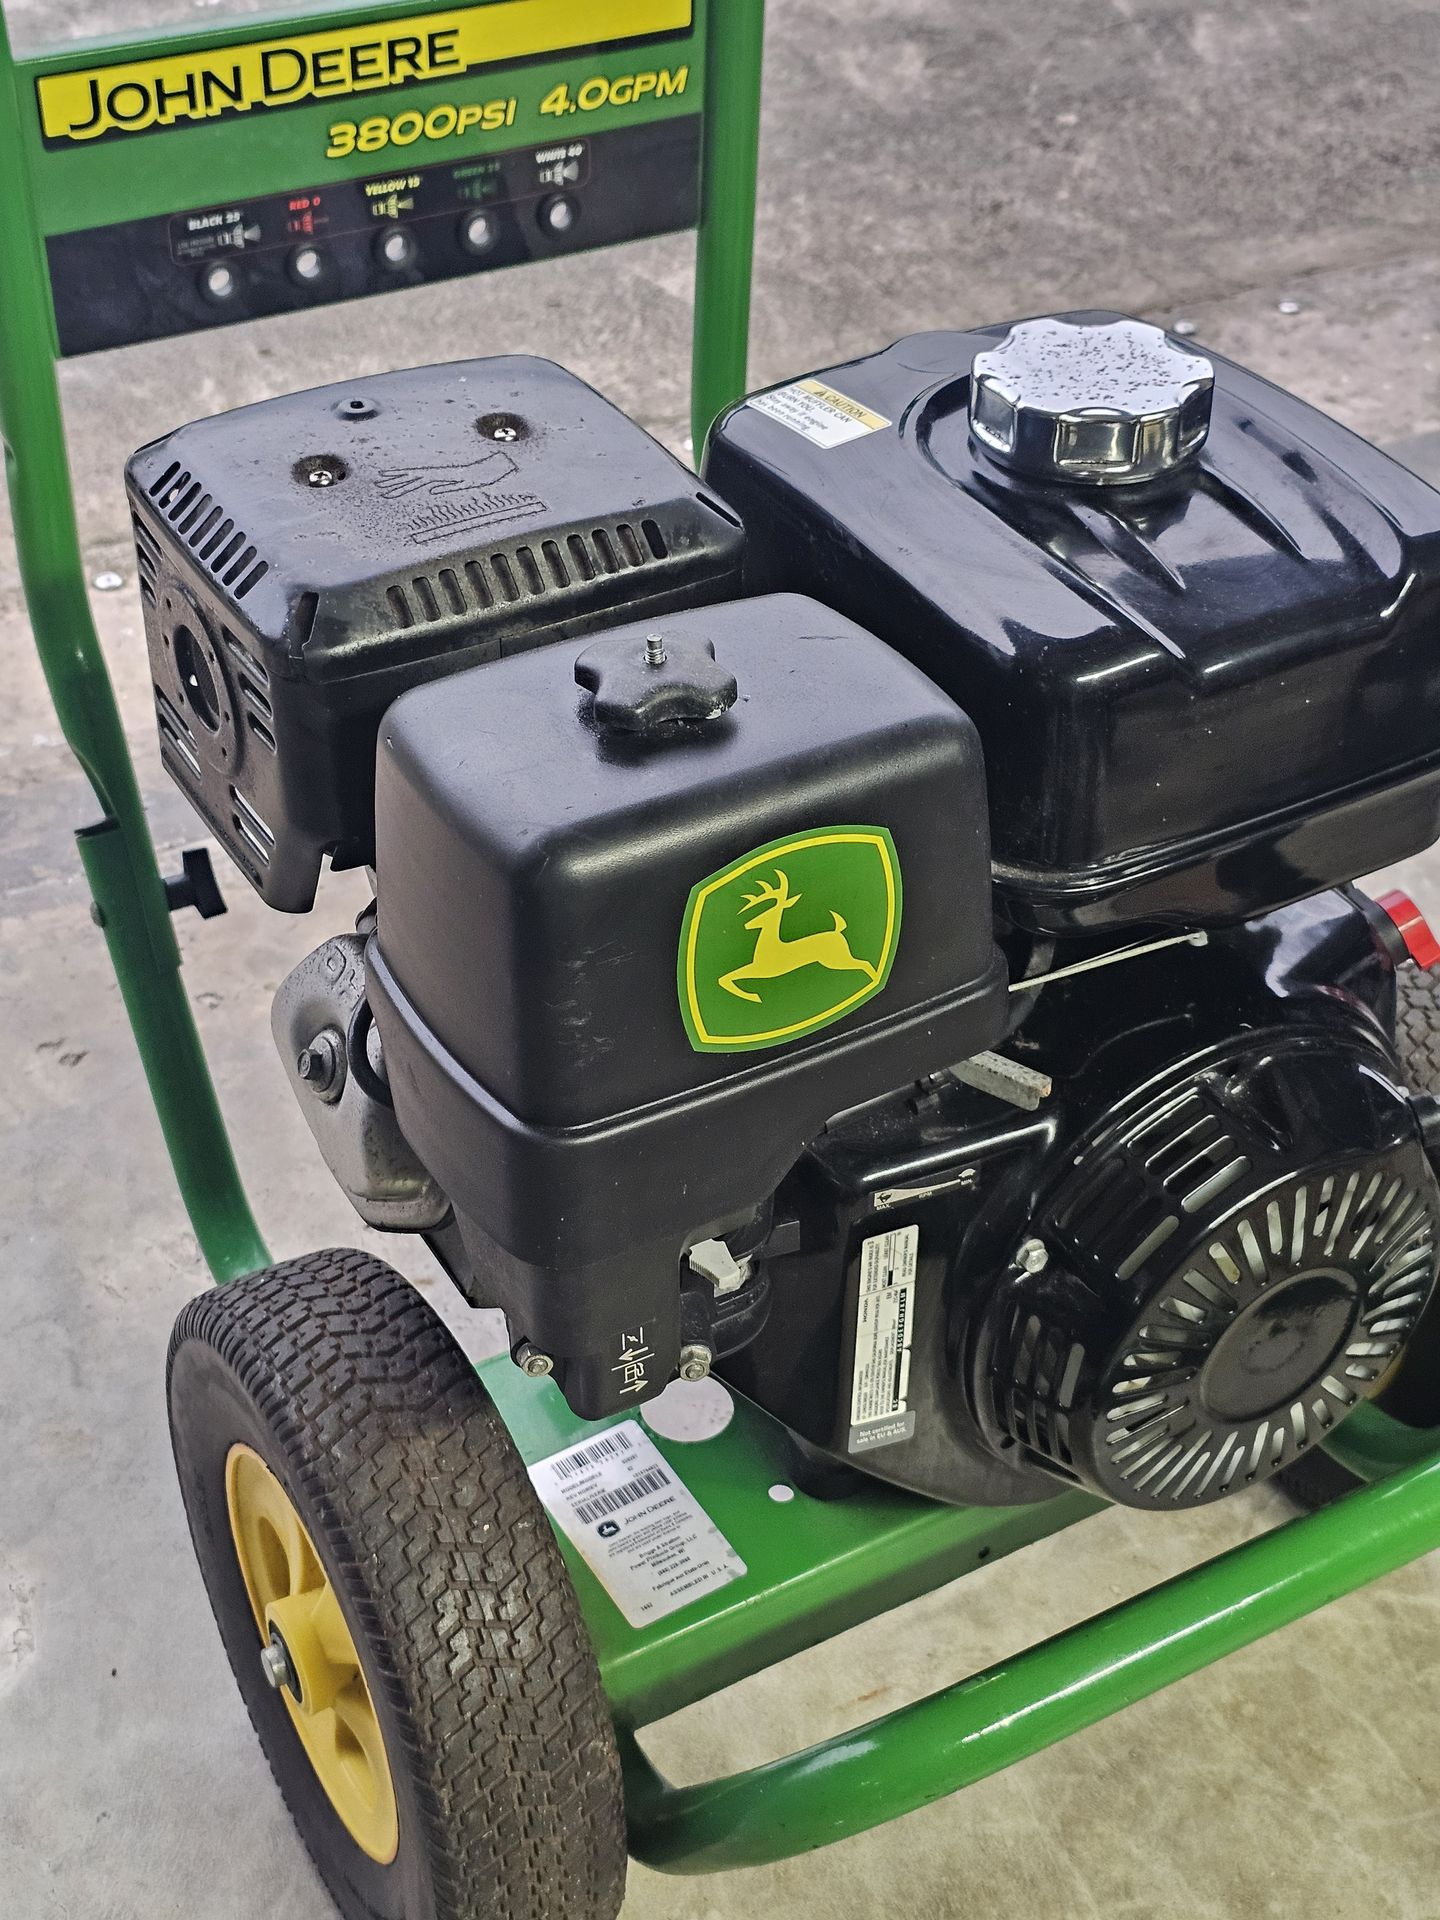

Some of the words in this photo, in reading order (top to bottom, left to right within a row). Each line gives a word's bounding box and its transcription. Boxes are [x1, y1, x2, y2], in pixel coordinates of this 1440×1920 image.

[70, 65, 245, 132] JOHN
[261, 29, 462, 97] DEERE
[326, 98, 517, 159] 3800PSI
[539, 65, 690, 117] 4.0GPM
[366, 178, 407, 196] YELLOW
[289, 199, 310, 211] RED
[313, 196, 321, 207] 0
[188, 214, 223, 231] BLACK
[825, 393, 868, 419] CAUTION
[834, 411, 853, 424] CAN
[622, 1509, 648, 1525] JOHN
[645, 1494, 676, 1513] DEERE
